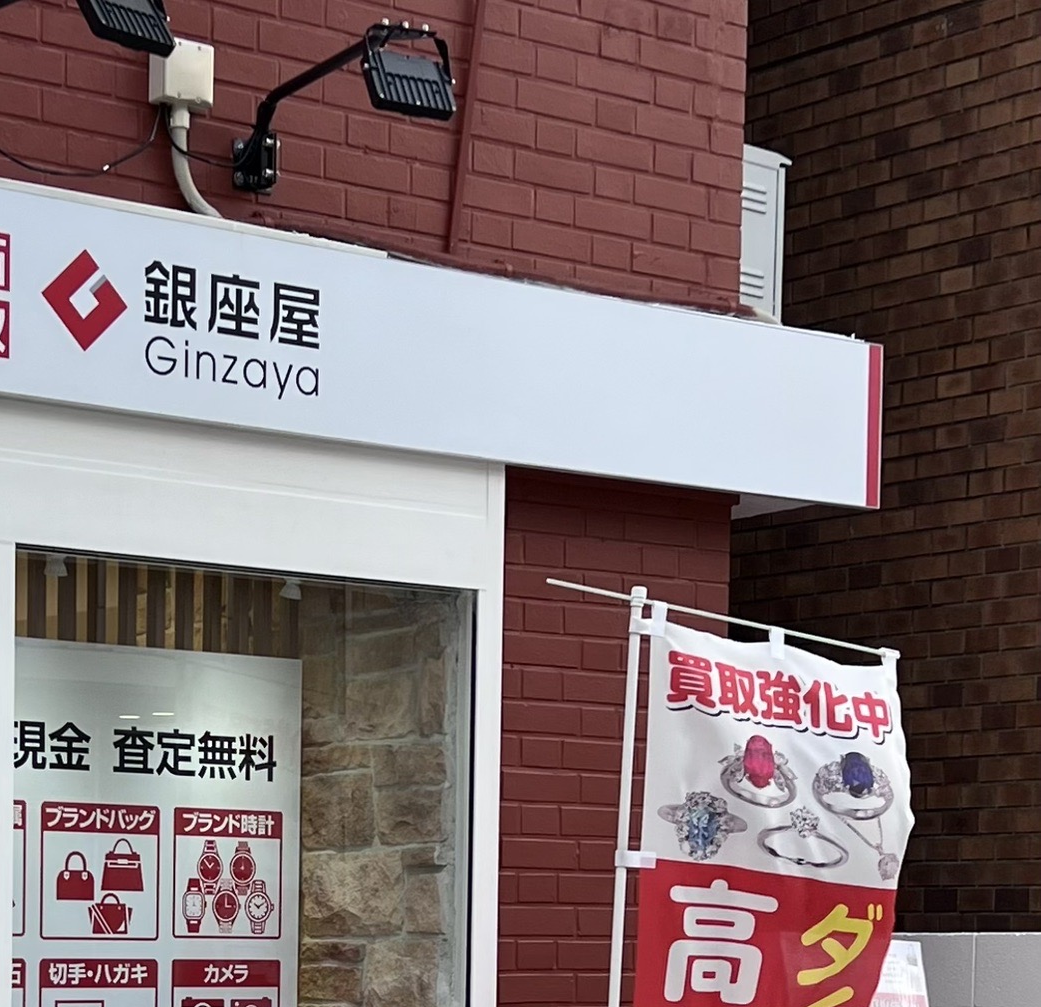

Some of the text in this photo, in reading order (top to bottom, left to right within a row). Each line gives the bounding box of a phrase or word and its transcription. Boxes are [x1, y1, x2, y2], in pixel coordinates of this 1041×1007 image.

[144, 260, 320, 349] 銀座屋
[145, 336, 320, 399] Ginzaya
[666, 649, 892, 740] 買取強化中
[112, 726, 277, 782] 査定無料
[45, 806, 157, 832] ブランドバッグ
[181, 811, 275, 837] ブランド時計
[48, 962, 149, 985] 切手・ハガキ
[203, 964, 250, 984] カメラ
